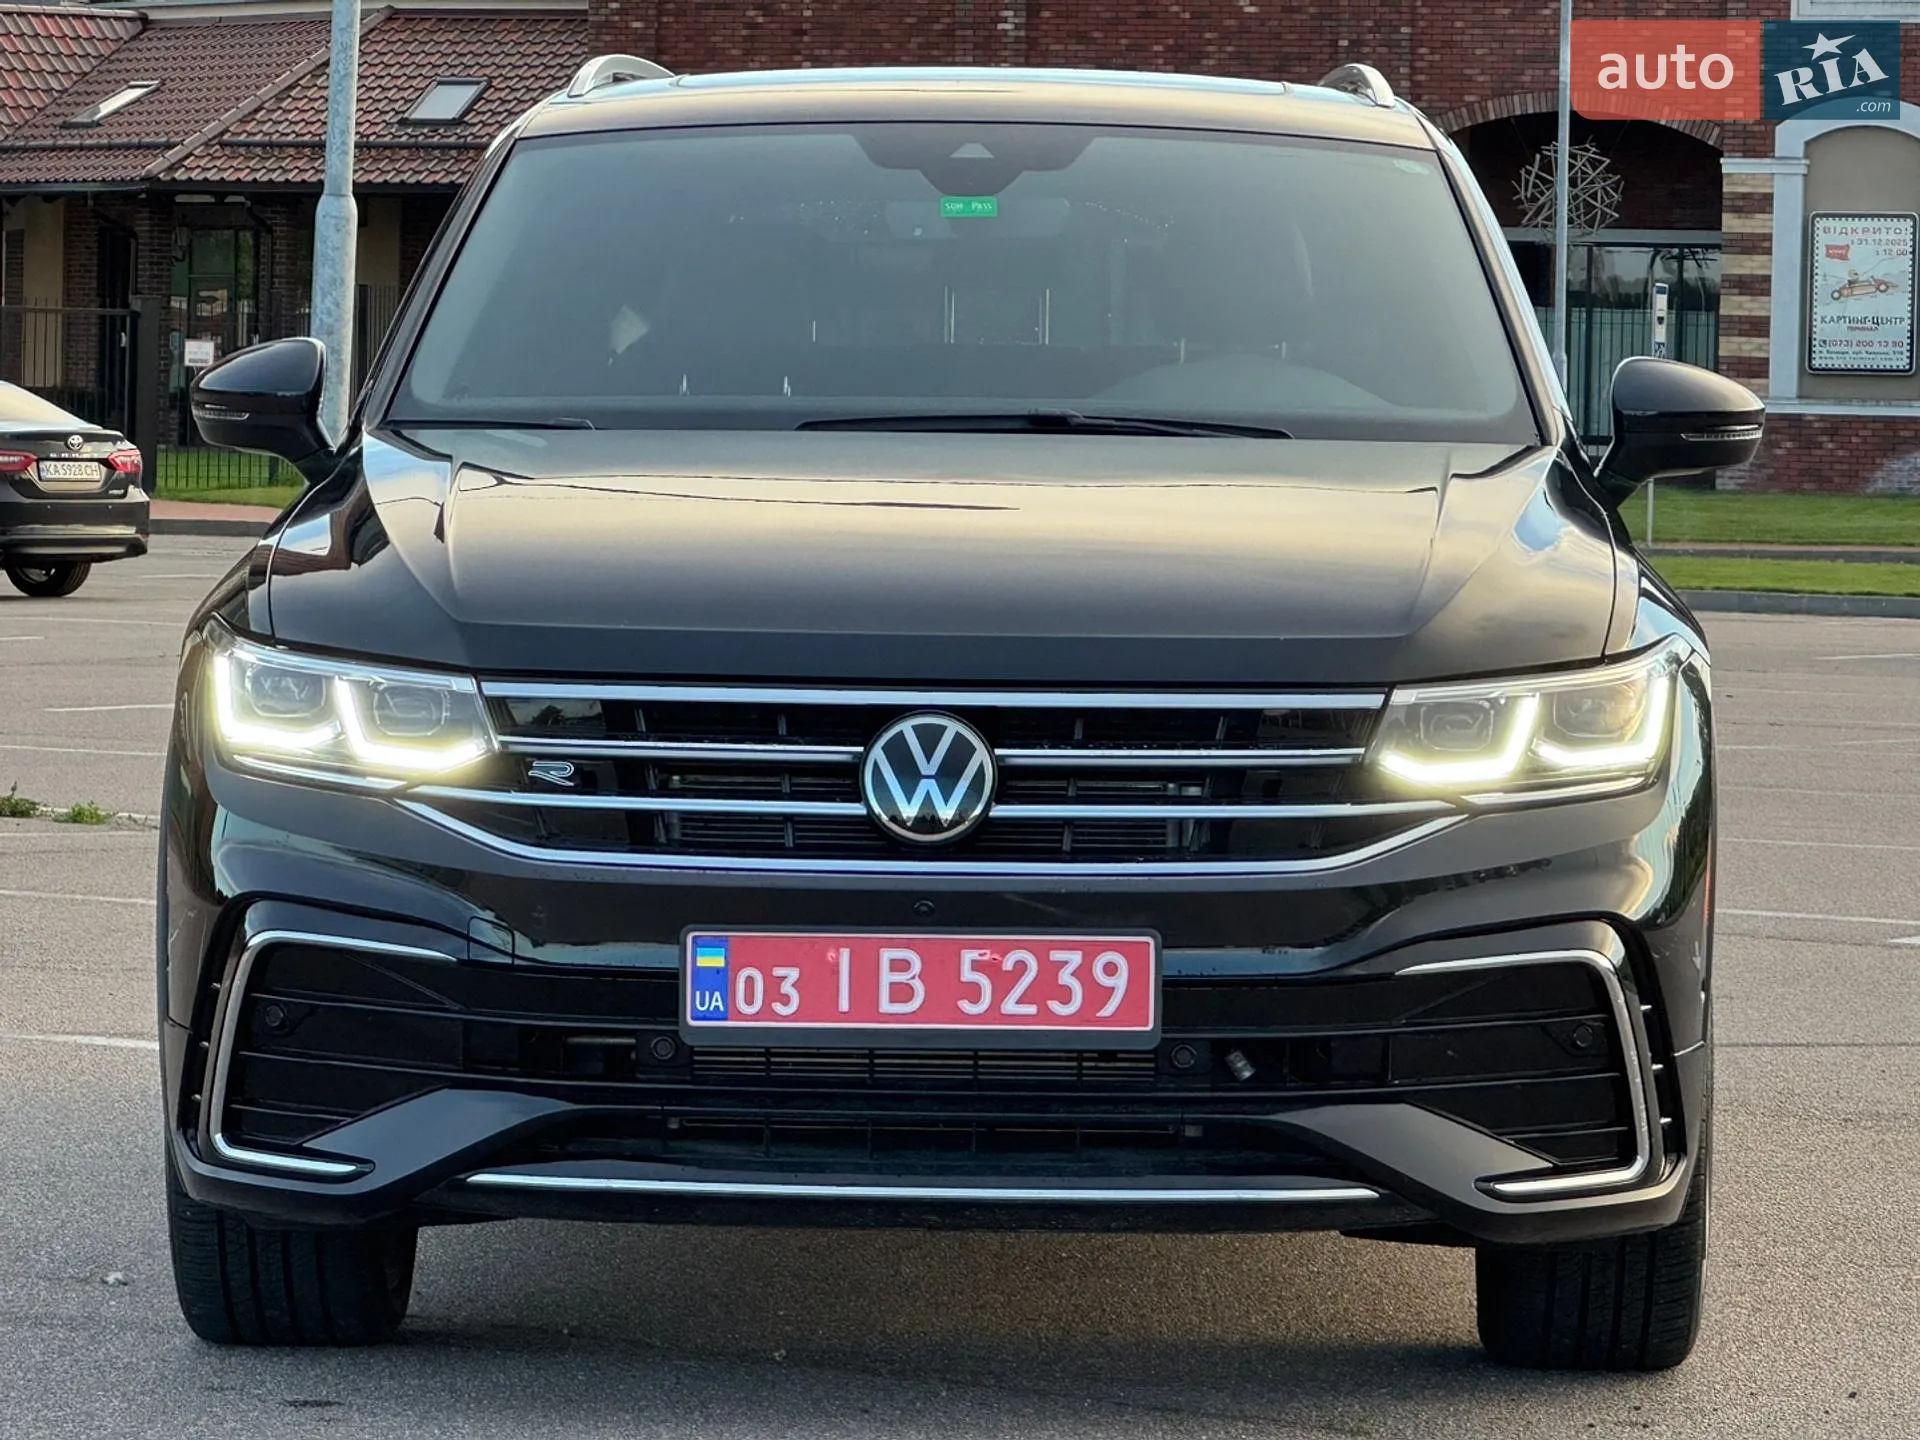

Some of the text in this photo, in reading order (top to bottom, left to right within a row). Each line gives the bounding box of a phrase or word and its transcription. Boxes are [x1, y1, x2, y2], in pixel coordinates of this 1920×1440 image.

[971, 202, 993, 210] PASS
[1822, 226, 1908, 235] ВІДКРИТО!
[735, 967, 801, 1017] 03
[956, 949, 1130, 1018] 5239
[695, 991, 725, 1012] UA
